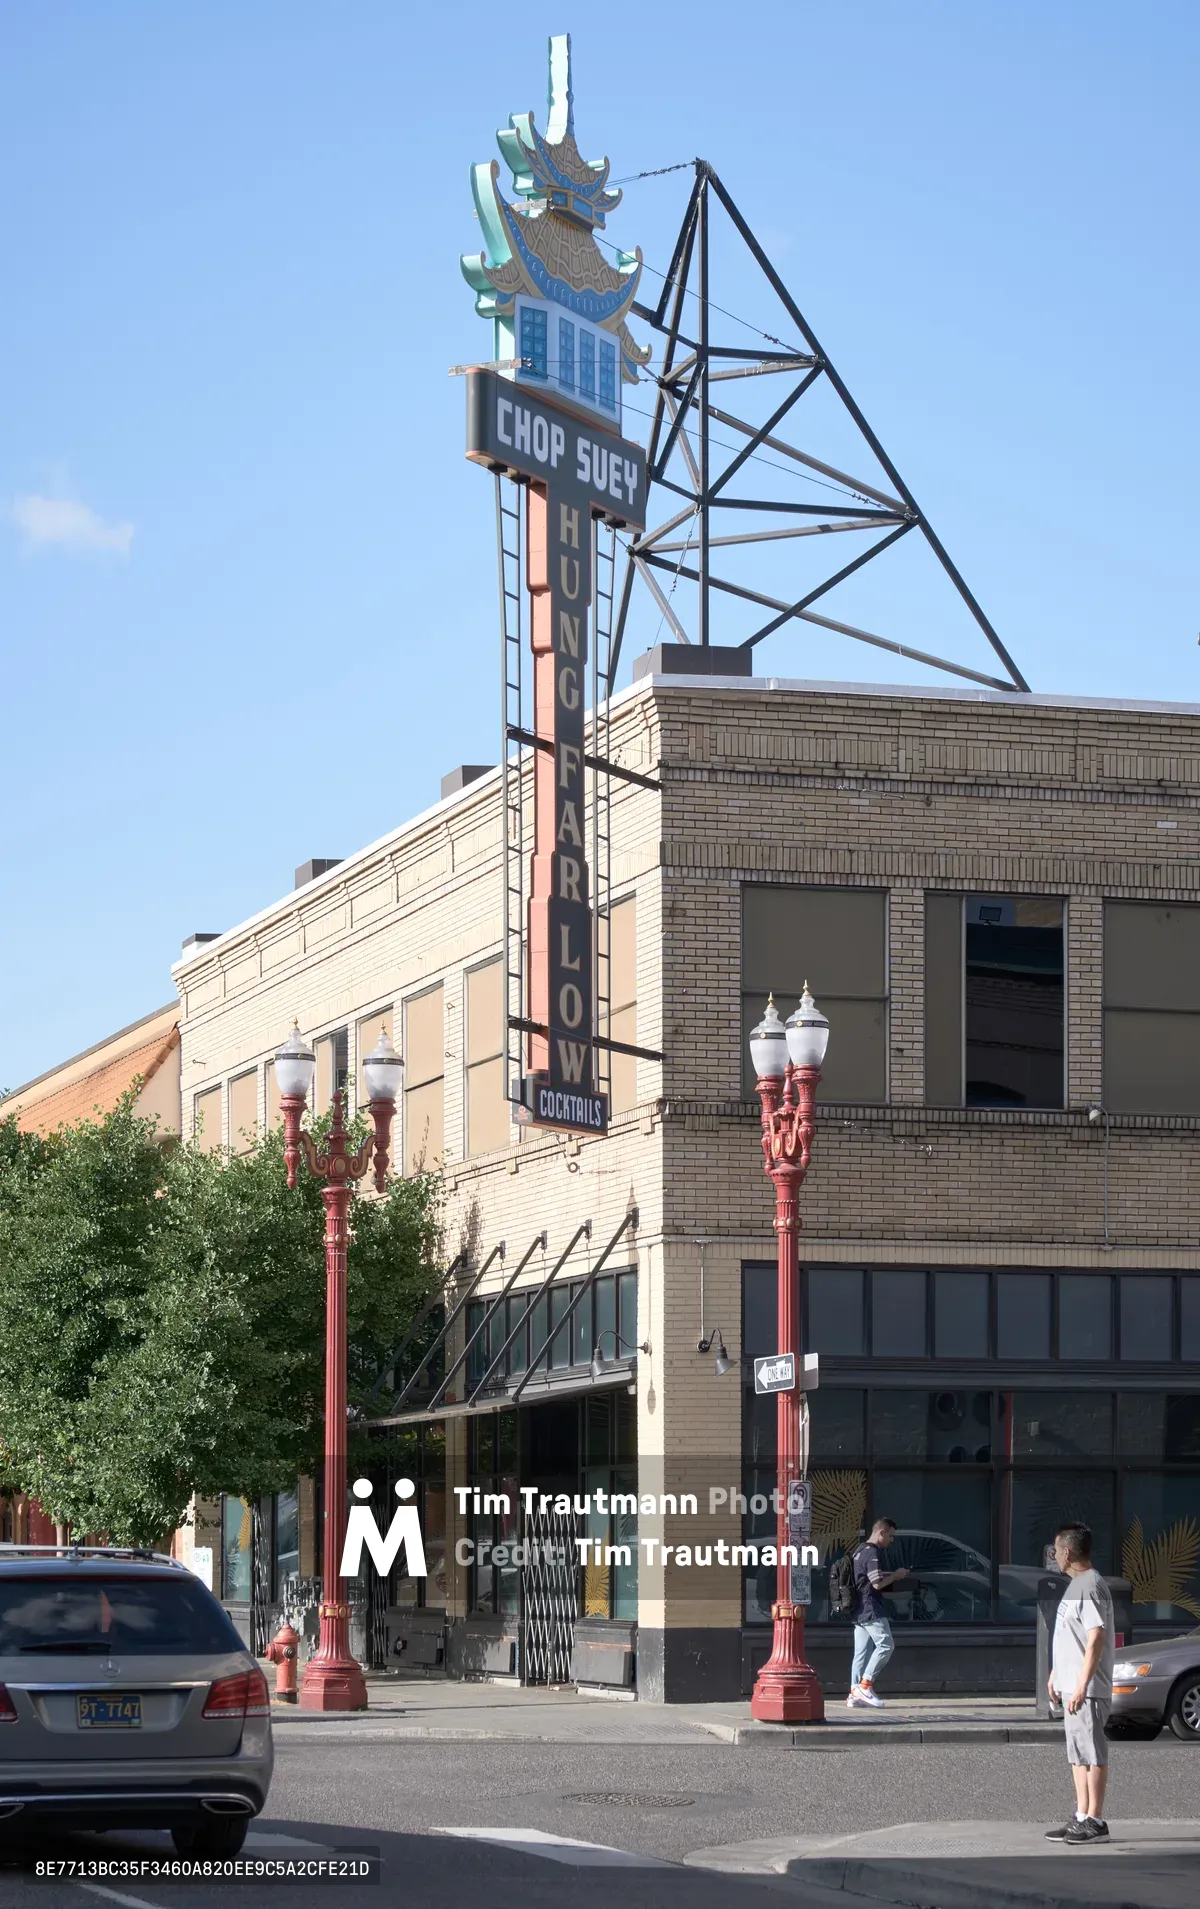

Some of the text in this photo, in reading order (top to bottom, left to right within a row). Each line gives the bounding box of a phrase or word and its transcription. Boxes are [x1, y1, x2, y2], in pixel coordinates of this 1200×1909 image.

[497, 397, 638, 506] CHOP SUEY
[557, 503, 589, 1085] HUNG FAR LOW
[540, 1089, 602, 1127] COCKTAILS
[768, 1365, 790, 1381] ONE WAY
